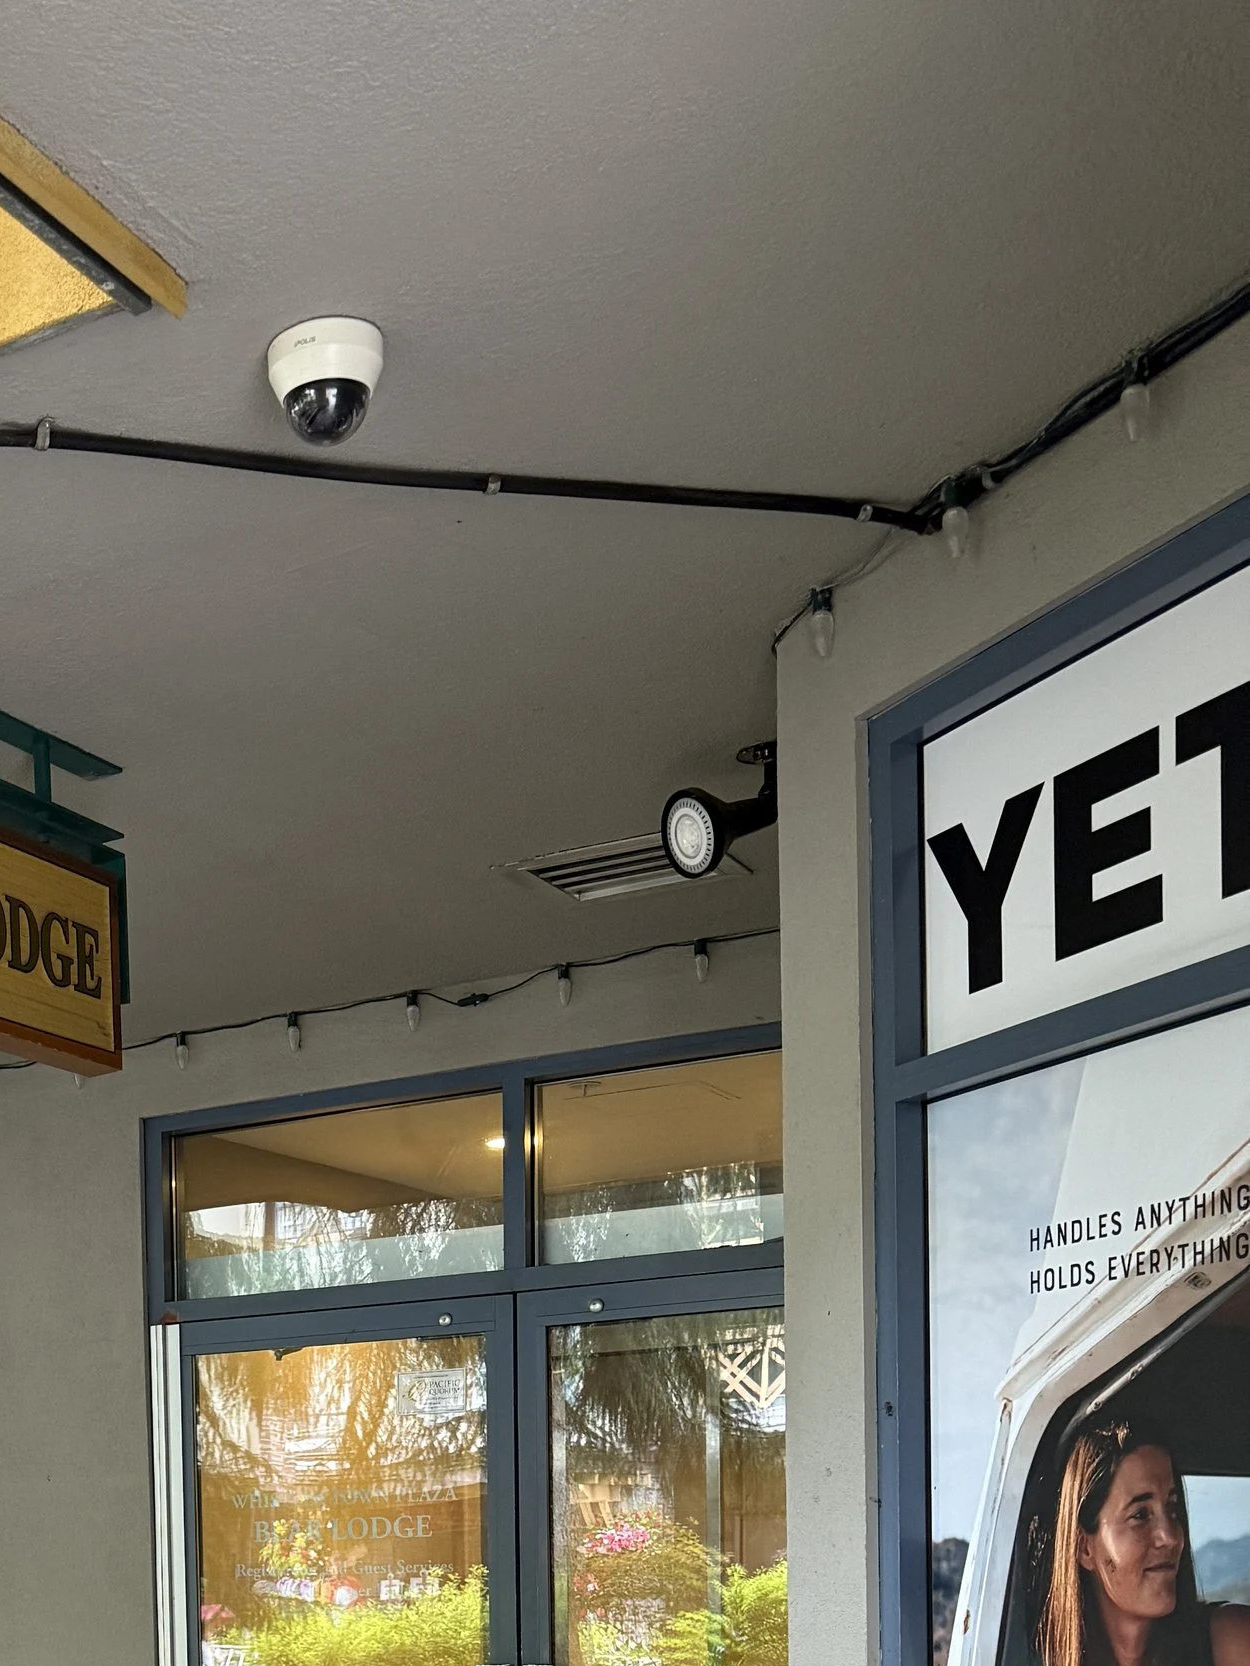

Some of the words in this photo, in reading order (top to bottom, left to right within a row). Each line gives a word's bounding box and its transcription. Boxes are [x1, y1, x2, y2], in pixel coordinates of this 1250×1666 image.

[927, 681, 1250, 995] YET
[1030, 1211, 1122, 1252] HANDLES
[1134, 1184, 1250, 1232] ANYTHING
[1030, 1260, 1096, 1295] HOLDS
[1108, 1232, 1250, 1281] EVERYTHING
[430, 1379, 460, 1388] PACIFIC
[232, 1490, 325, 1509] WHISTR
[332, 1486, 389, 1506] TOWN
[395, 1486, 458, 1503] PLAZA
[332, 1514, 433, 1541] LODGE
[236, 1563, 317, 1582] Regison
[352, 1559, 391, 1575] Guest
[396, 1558, 454, 1575] Services
